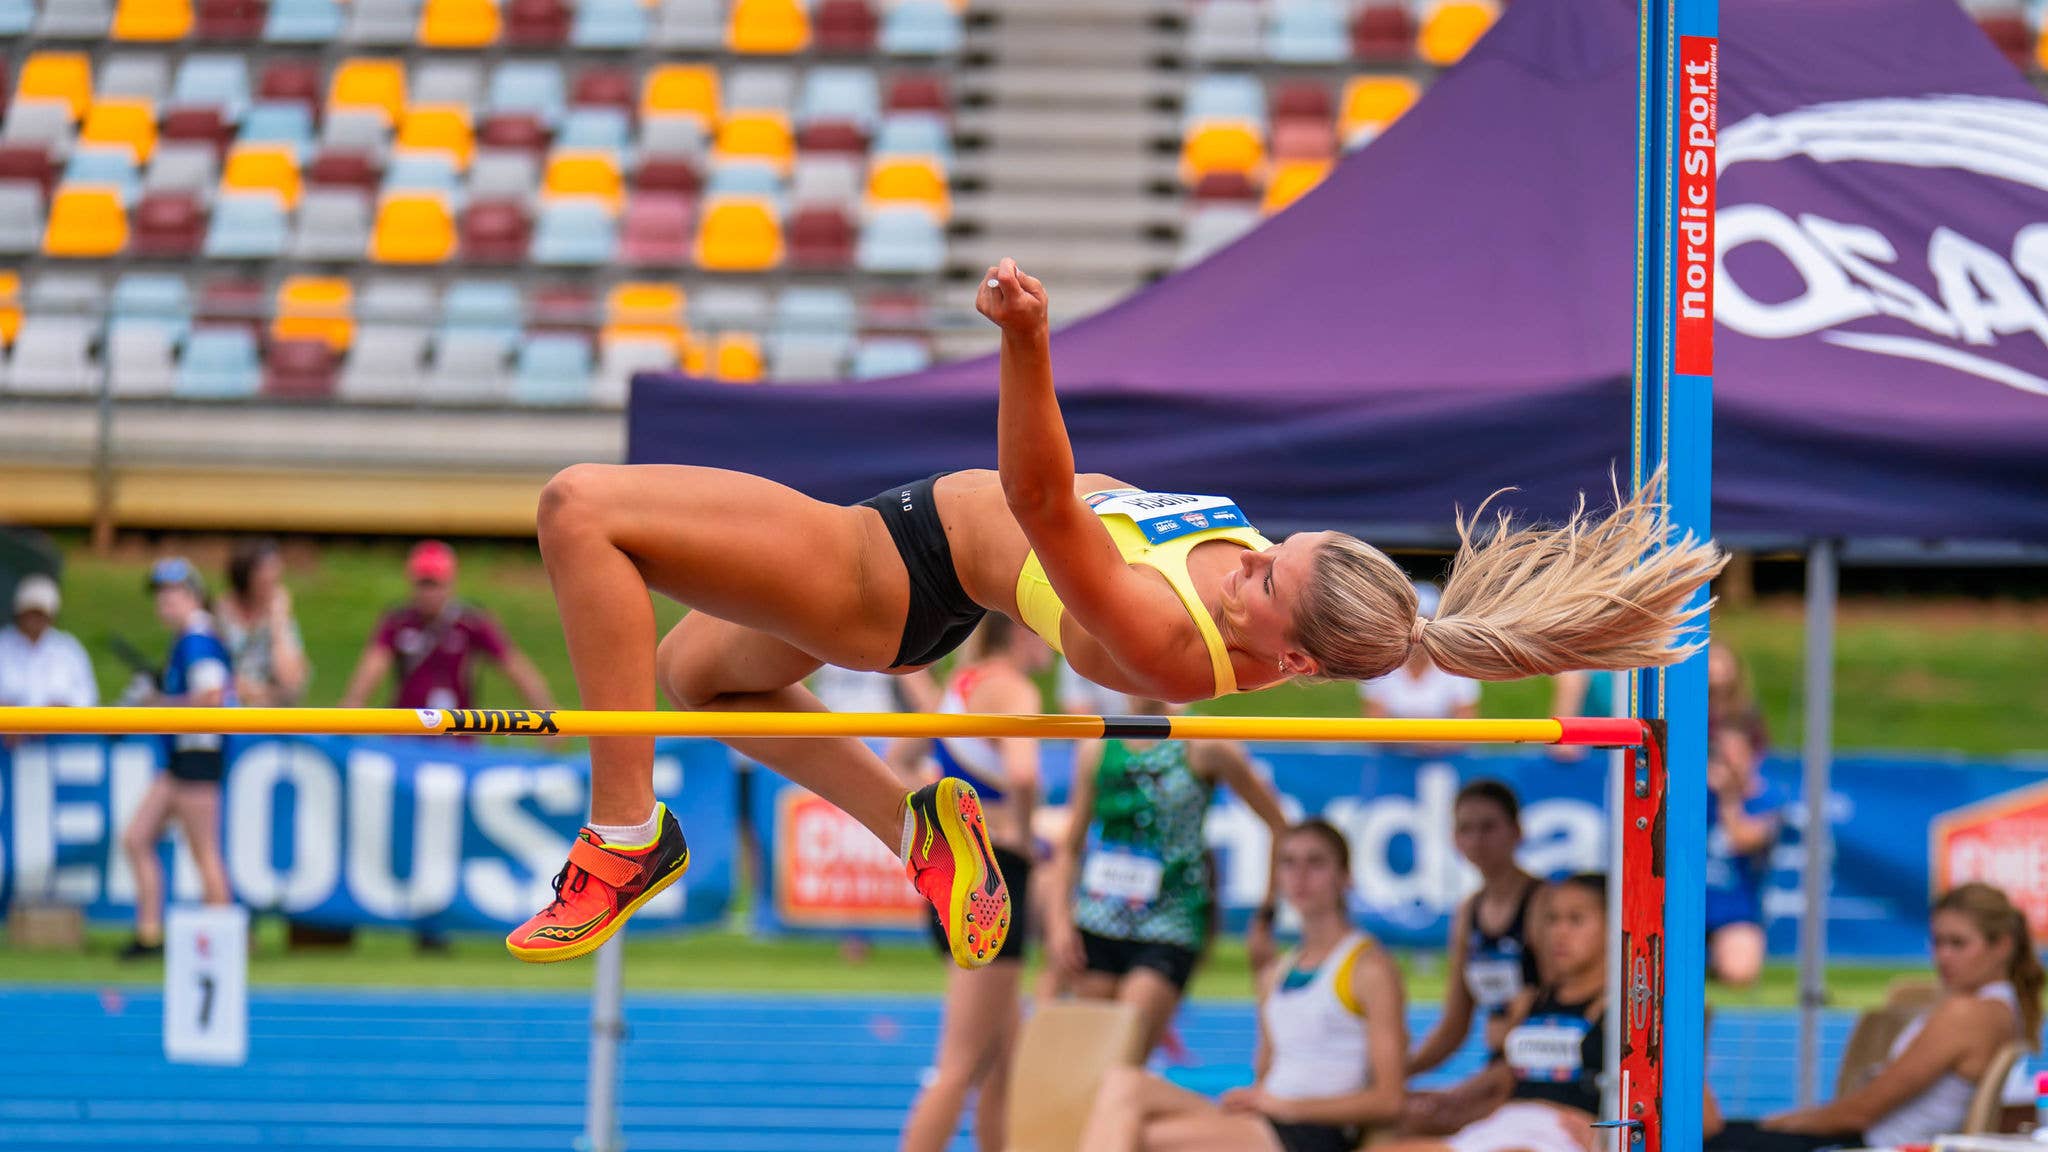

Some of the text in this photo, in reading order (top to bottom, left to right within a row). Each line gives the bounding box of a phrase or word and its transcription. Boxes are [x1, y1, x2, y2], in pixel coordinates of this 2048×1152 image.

[1709, 43, 1718, 90] Lappland
[1709, 103, 1717, 130] made
[1681, 59, 1715, 318] nordic Sport
